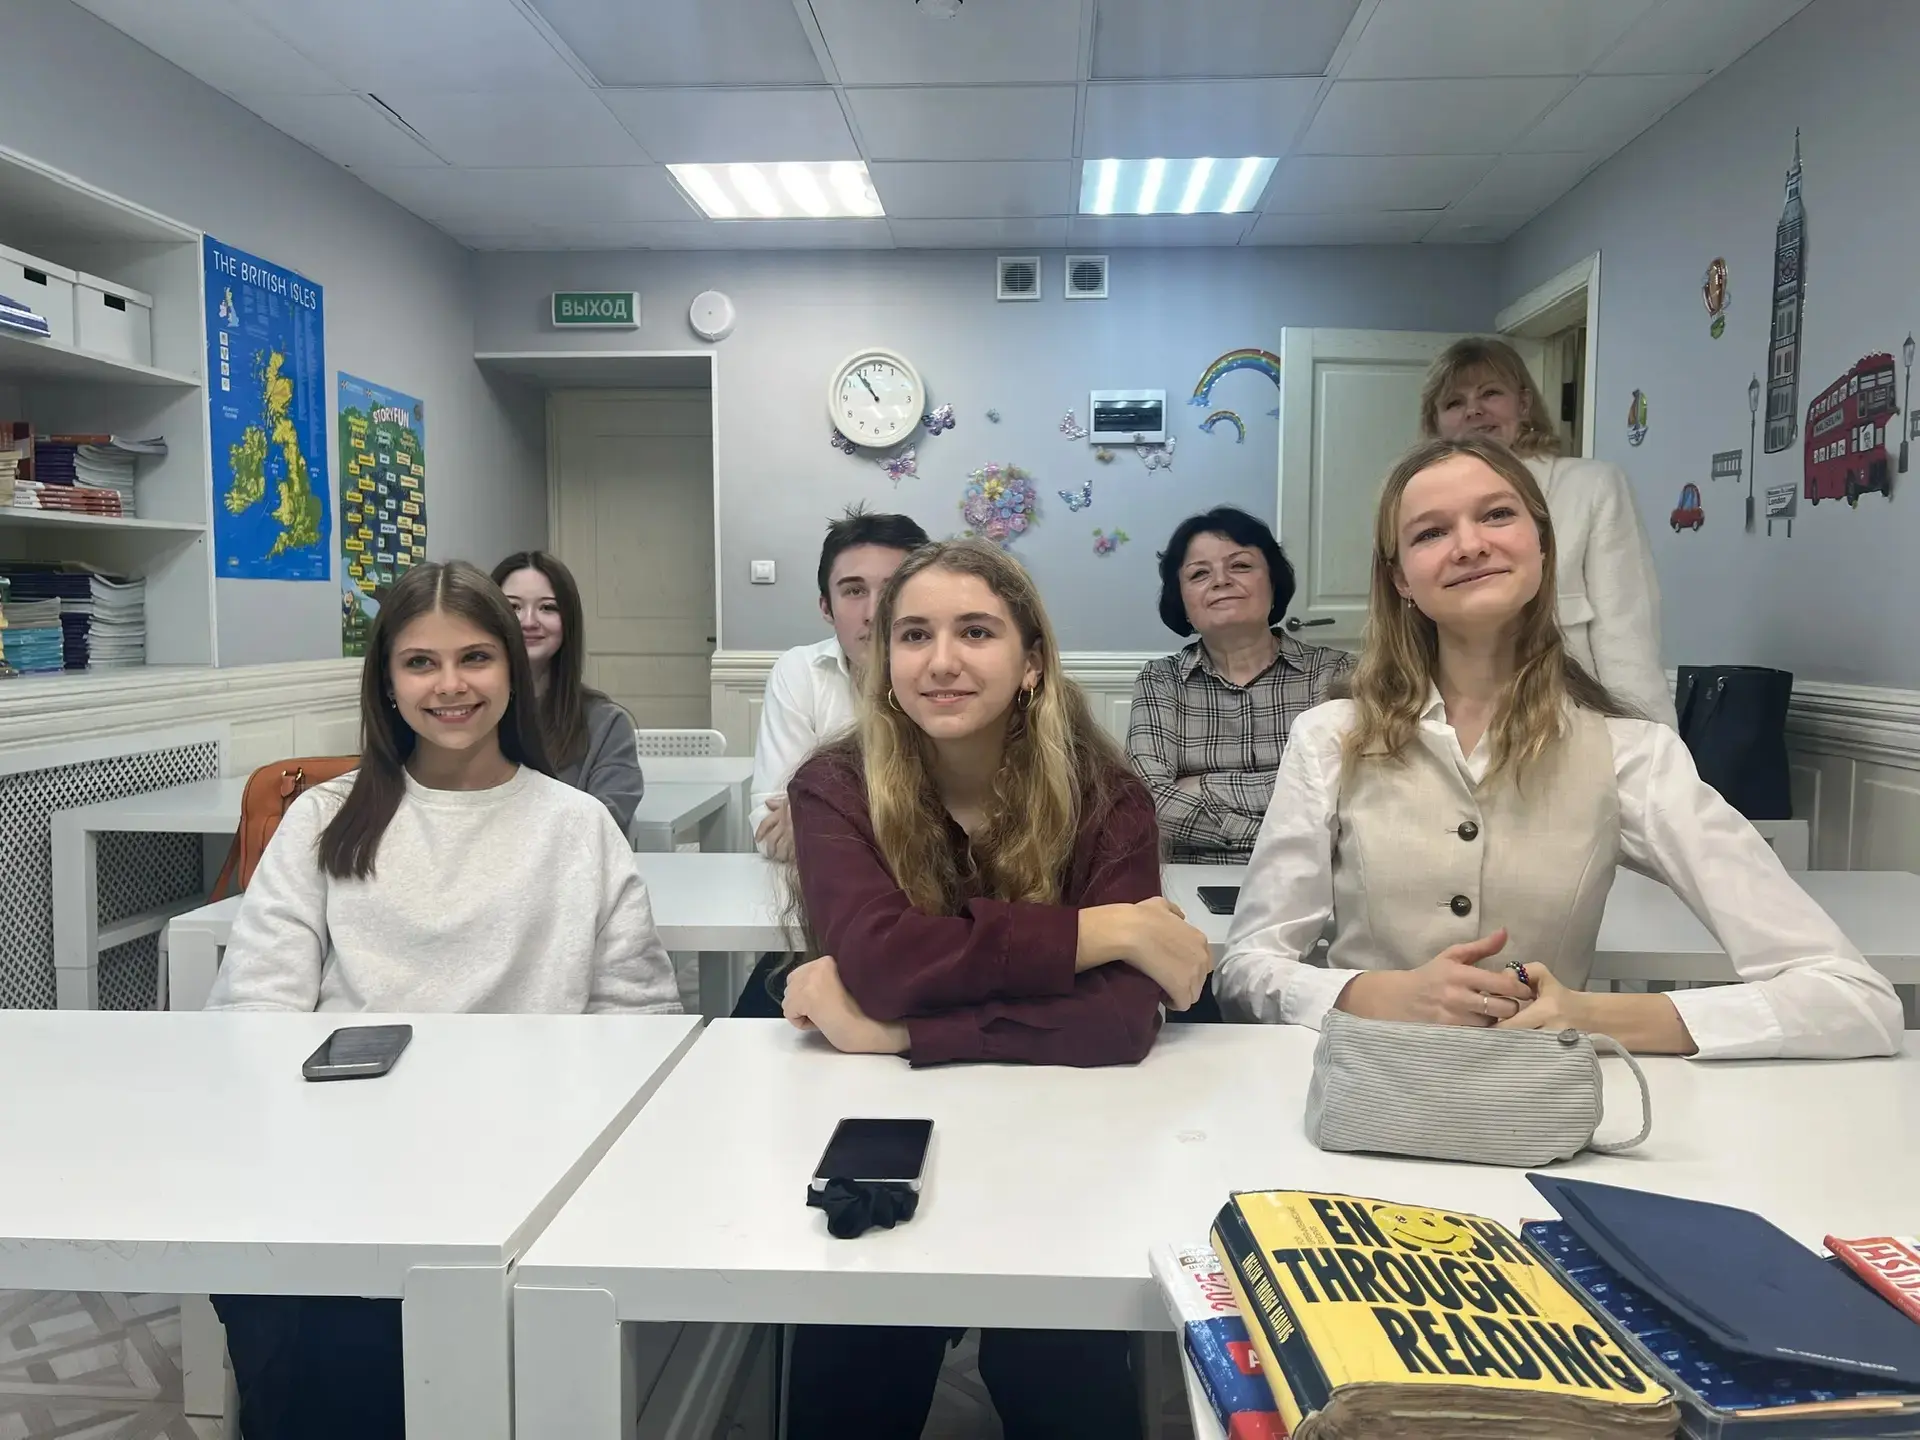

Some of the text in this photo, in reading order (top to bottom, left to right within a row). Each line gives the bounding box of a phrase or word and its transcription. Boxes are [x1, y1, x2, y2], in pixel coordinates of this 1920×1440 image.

[213, 250, 237, 277] THE
[241, 262, 287, 297] BRITISH
[290, 282, 316, 310] ISLES
[561, 299, 628, 319] ВЫХОД
[872, 363, 883, 372] 12
[890, 368, 895, 376] 1
[843, 394, 848, 402] 9
[906, 395, 912, 403] 3
[373, 407, 409, 428] STORYFUN
[847, 410, 853, 418] 8
[860, 421, 865, 430] 7
[890, 422, 895, 430] 5
[1271, 1247, 1540, 1317] THROUGH
[1193, 1271, 1241, 1312] 2025
[1241, 1251, 1295, 1344] ENGLISH THROUGH READING
[1370, 1306, 1647, 1394] READING
